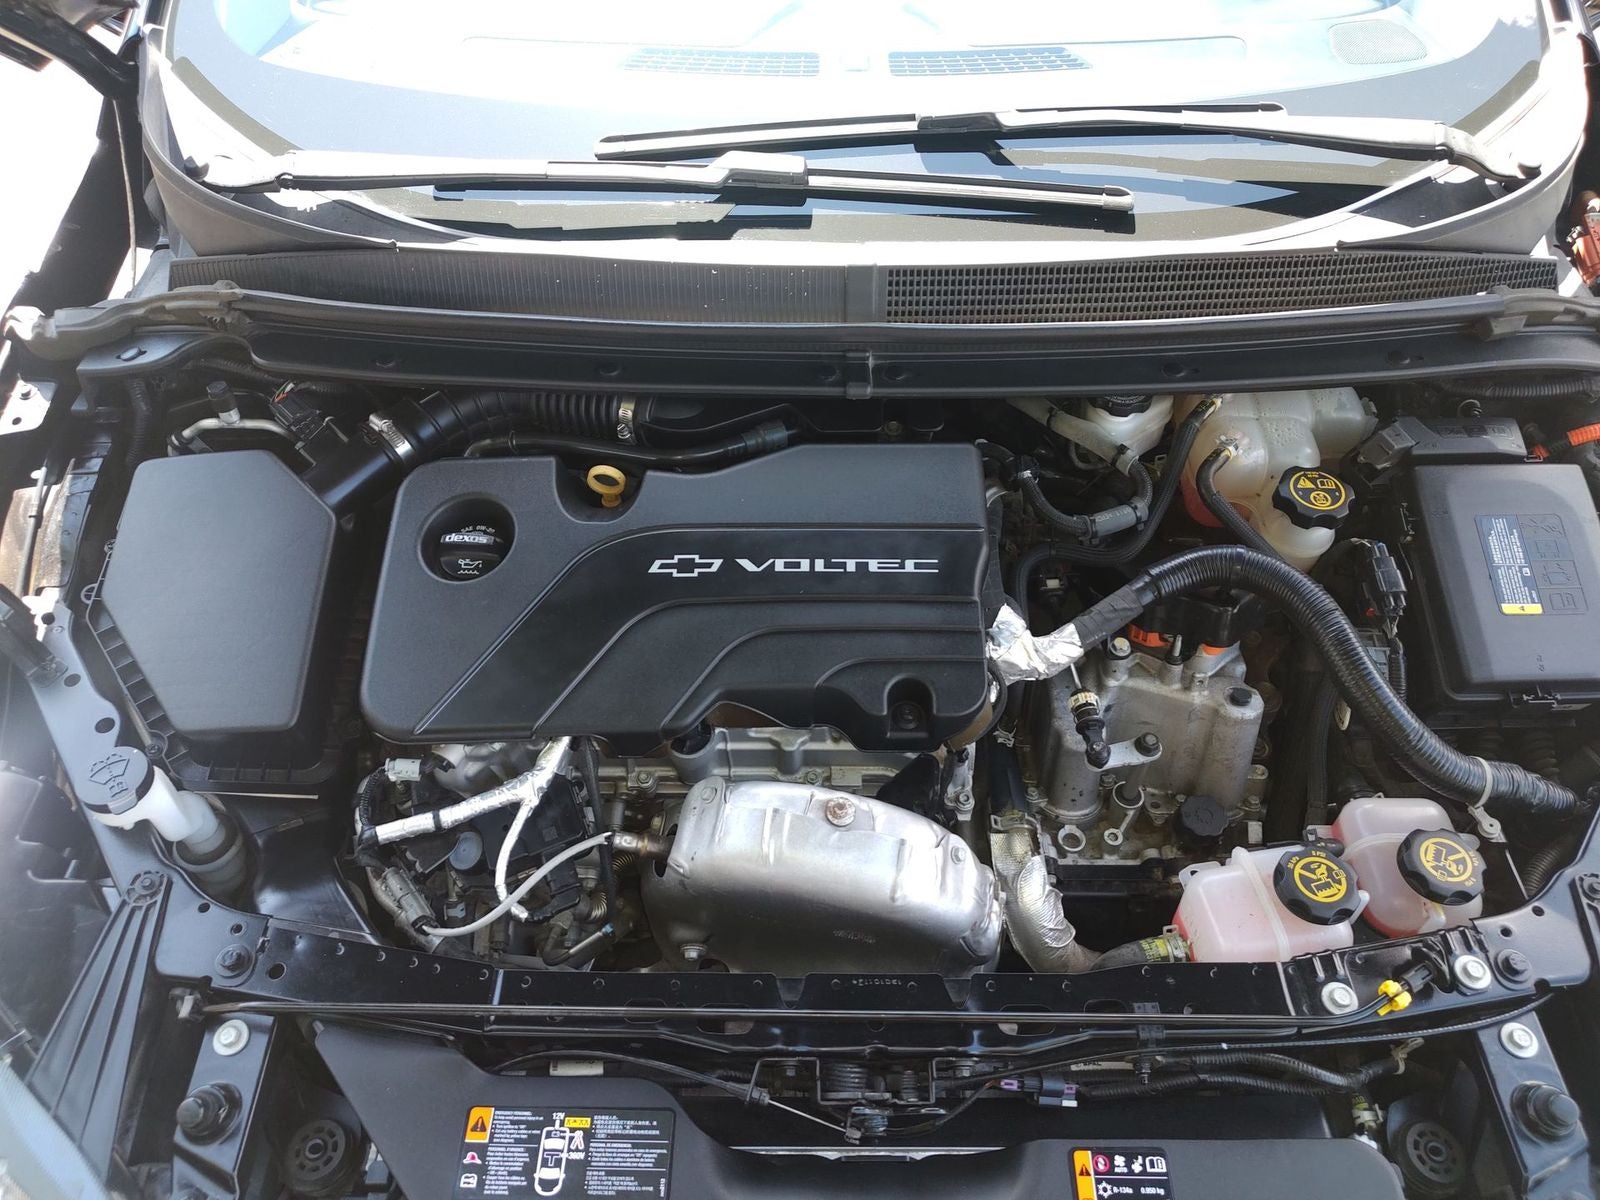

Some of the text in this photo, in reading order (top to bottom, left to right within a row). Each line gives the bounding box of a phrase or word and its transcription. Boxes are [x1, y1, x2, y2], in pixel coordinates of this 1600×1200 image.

[445, 533, 487, 543] dexos
[735, 558, 939, 573] VOLTEC
[552, 1112, 565, 1120] 12V
[1157, 1187, 1165, 1195] kg
